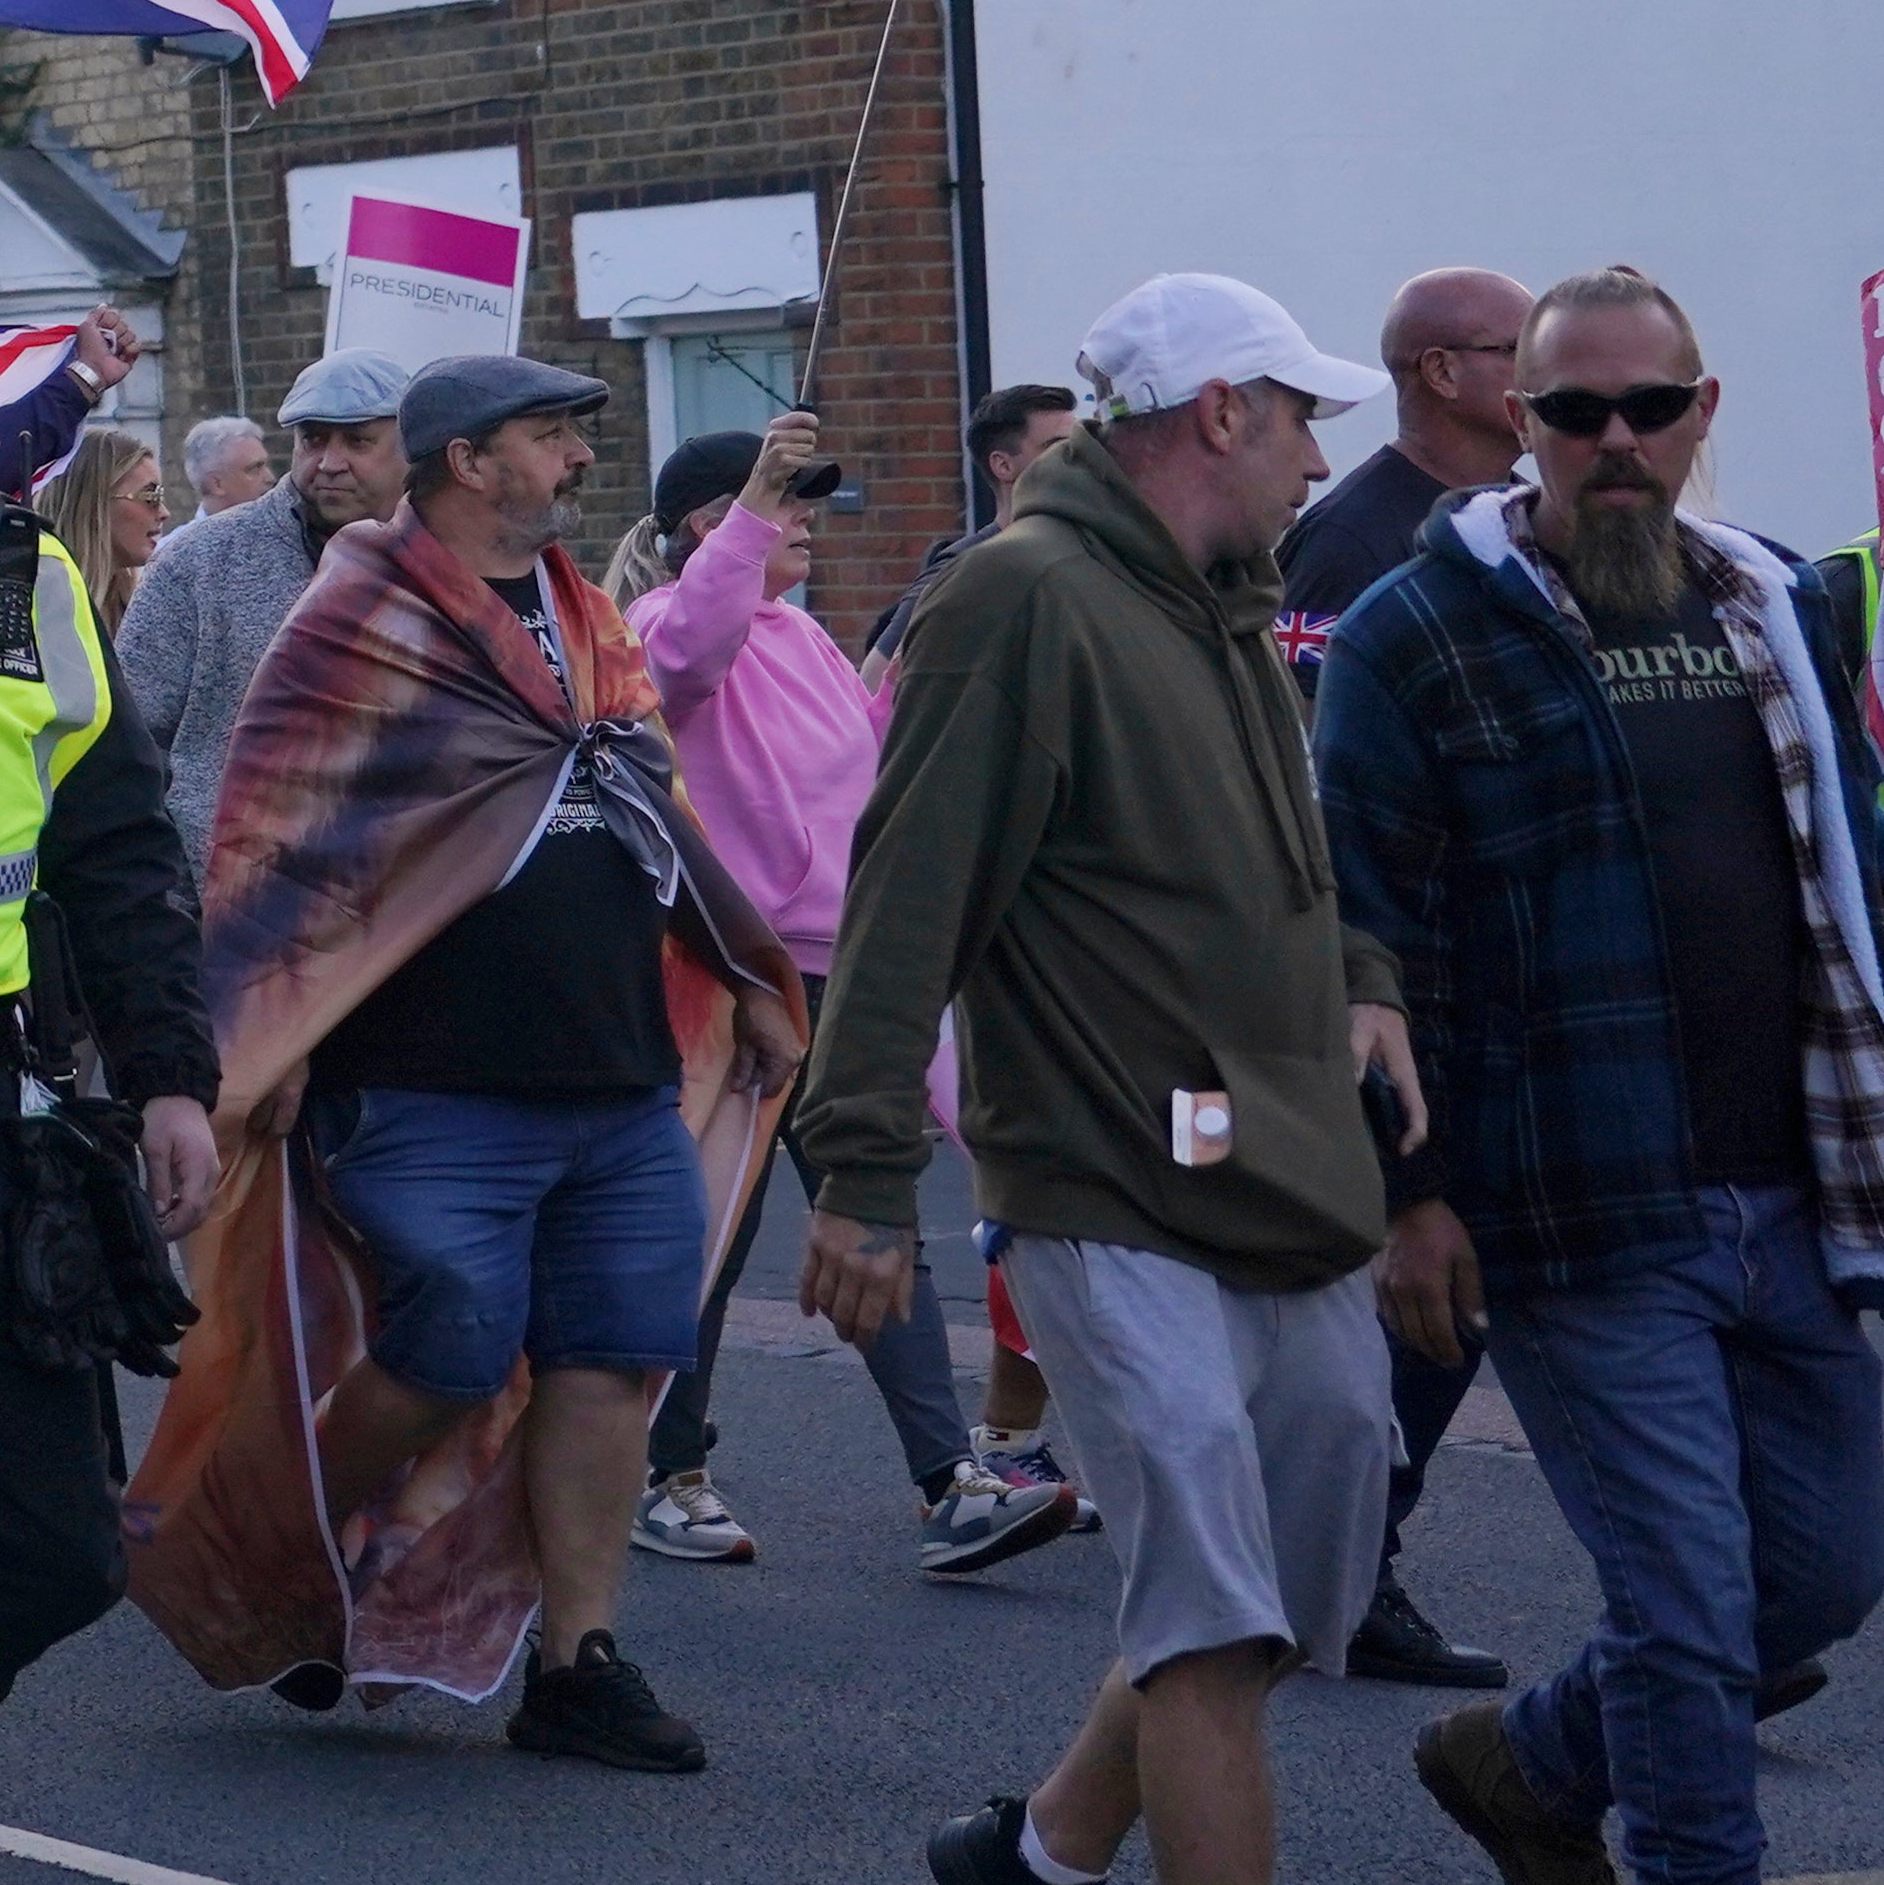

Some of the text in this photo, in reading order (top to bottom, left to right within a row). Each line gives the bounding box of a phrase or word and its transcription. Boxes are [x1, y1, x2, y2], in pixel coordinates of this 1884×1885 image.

[350, 272, 506, 318] PRESIDENTIAL
[3, 658, 39, 676] OFFICER
[1608, 681, 1655, 704] AKES
[1659, 680, 1675, 700] IT
